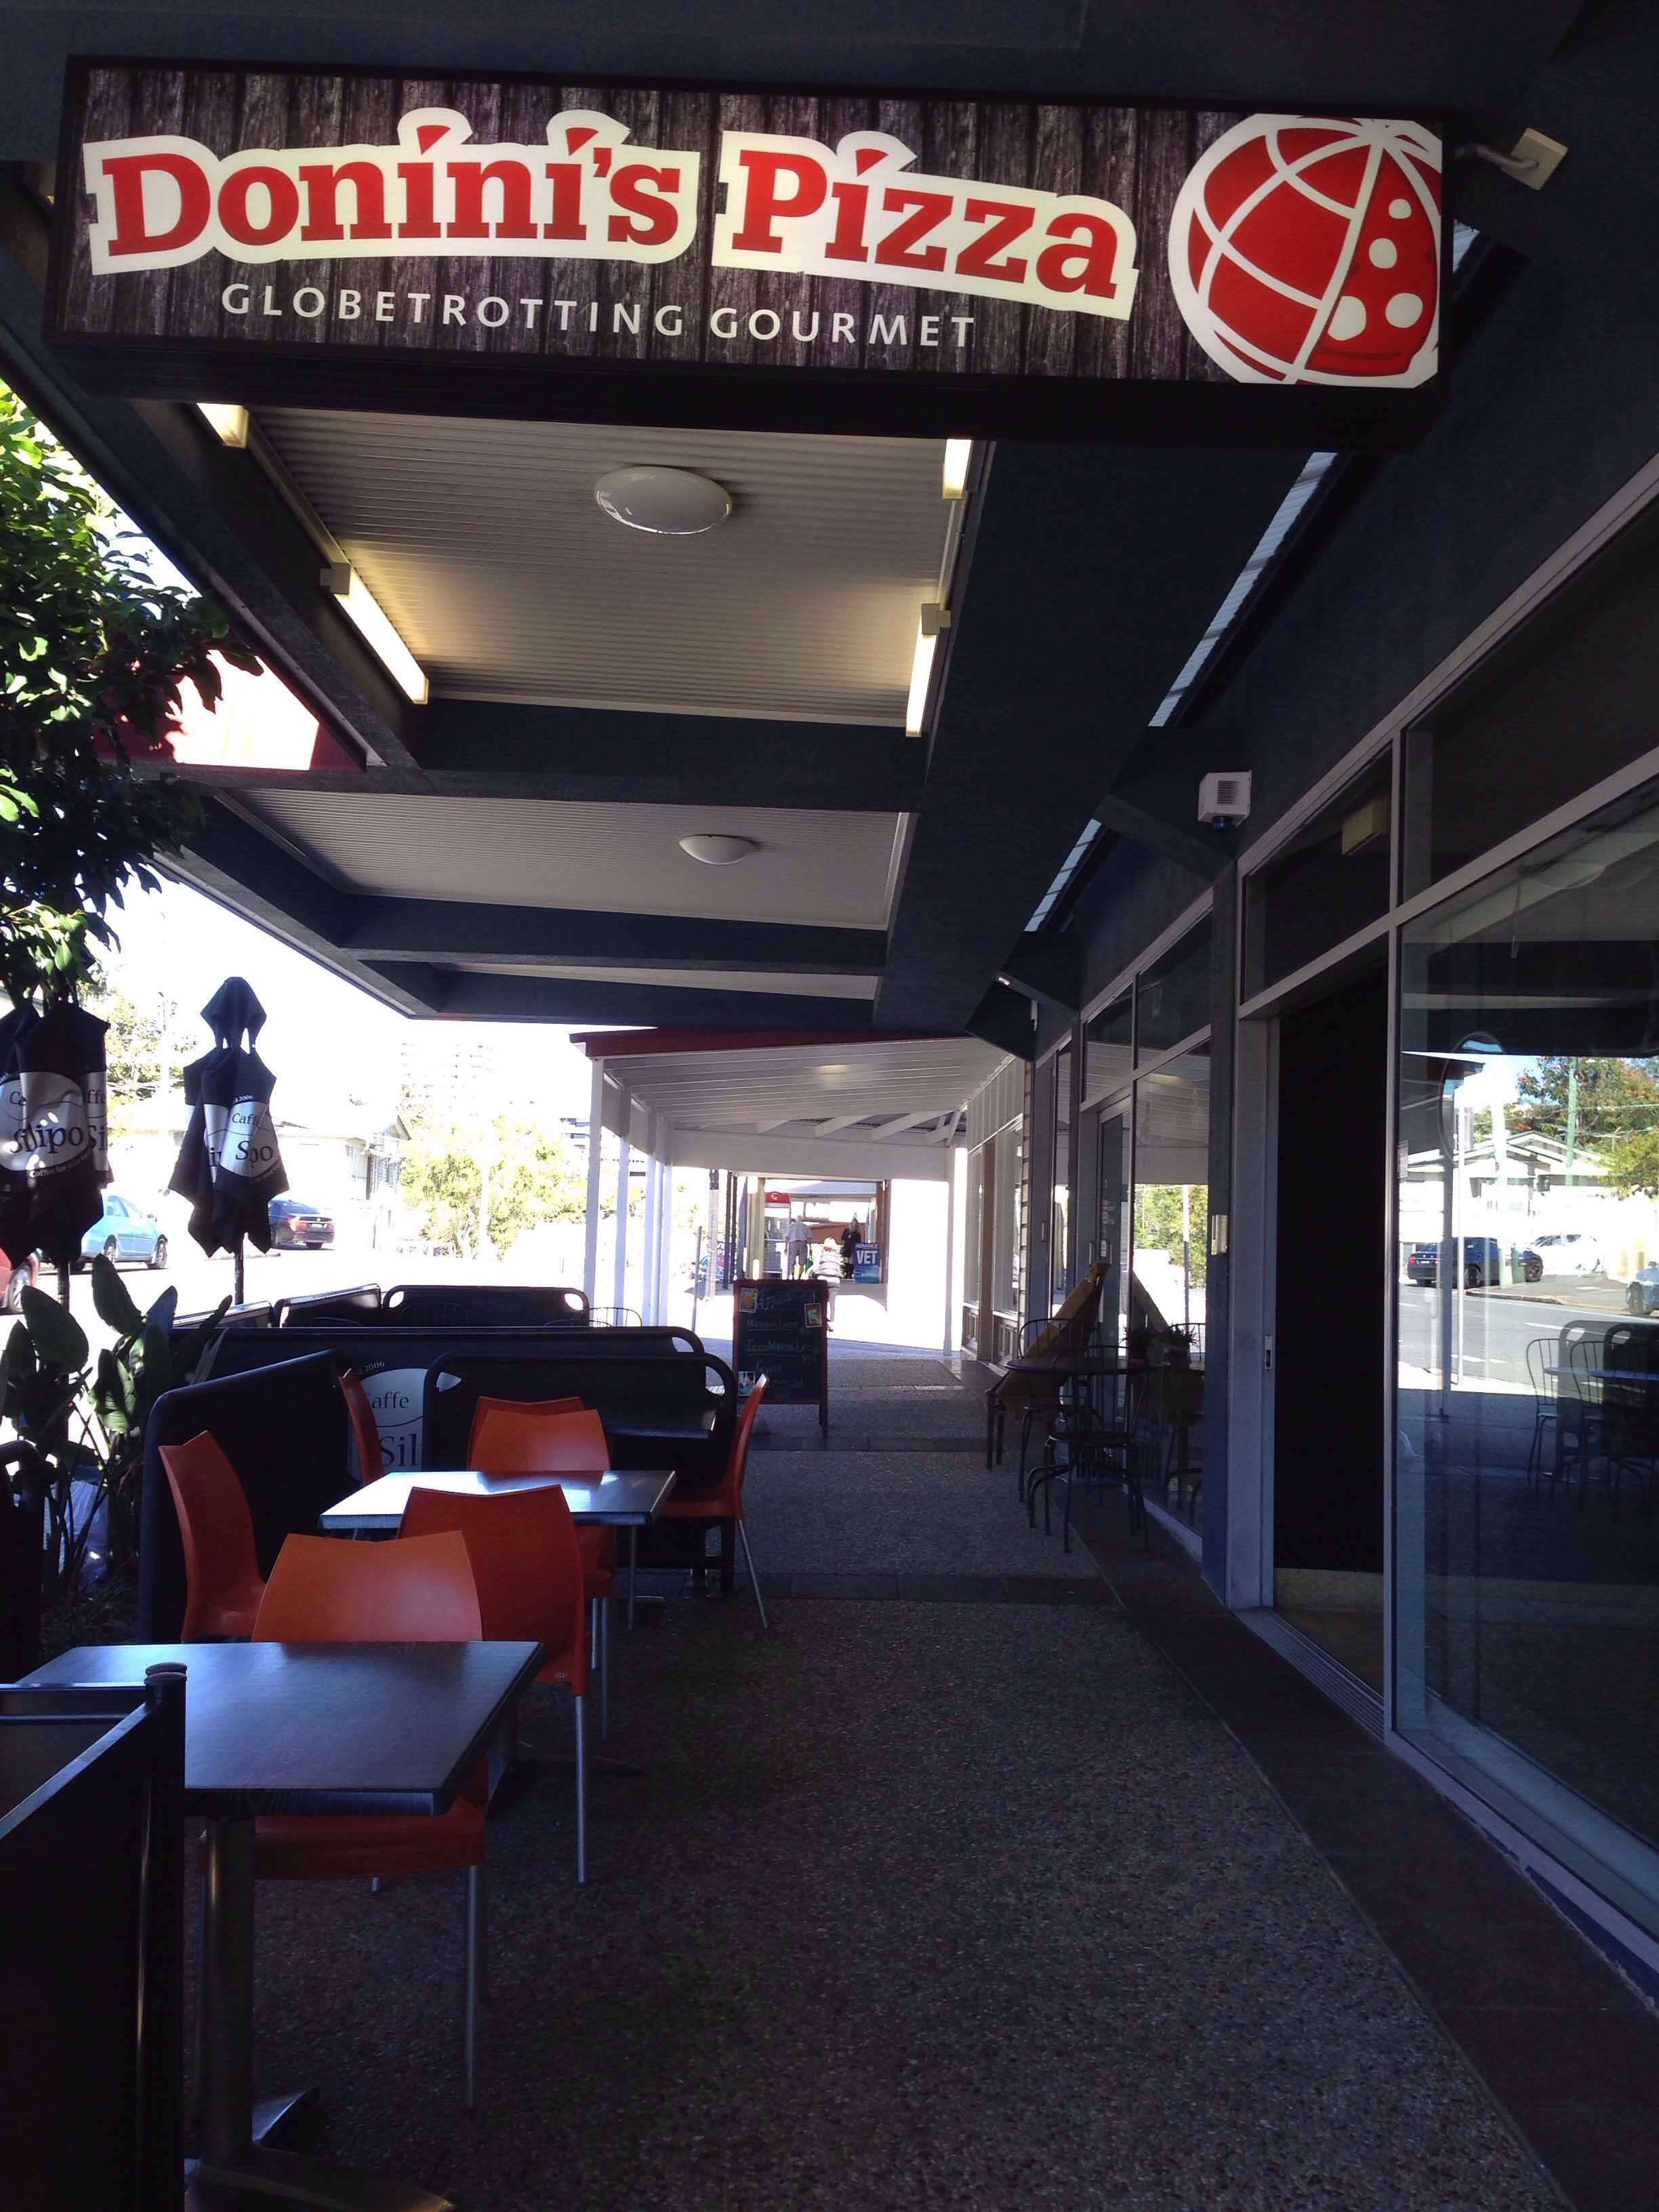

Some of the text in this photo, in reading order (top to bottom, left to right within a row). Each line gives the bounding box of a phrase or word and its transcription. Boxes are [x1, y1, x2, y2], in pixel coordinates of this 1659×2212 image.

[102, 124, 1118, 300] Donini's Pizza
[221, 283, 976, 348] GLOBETROTTING GOURMET
[856, 1250, 878, 1265] VET
[371, 1391, 409, 1409] affe
[380, 1433, 419, 1467] Sil
